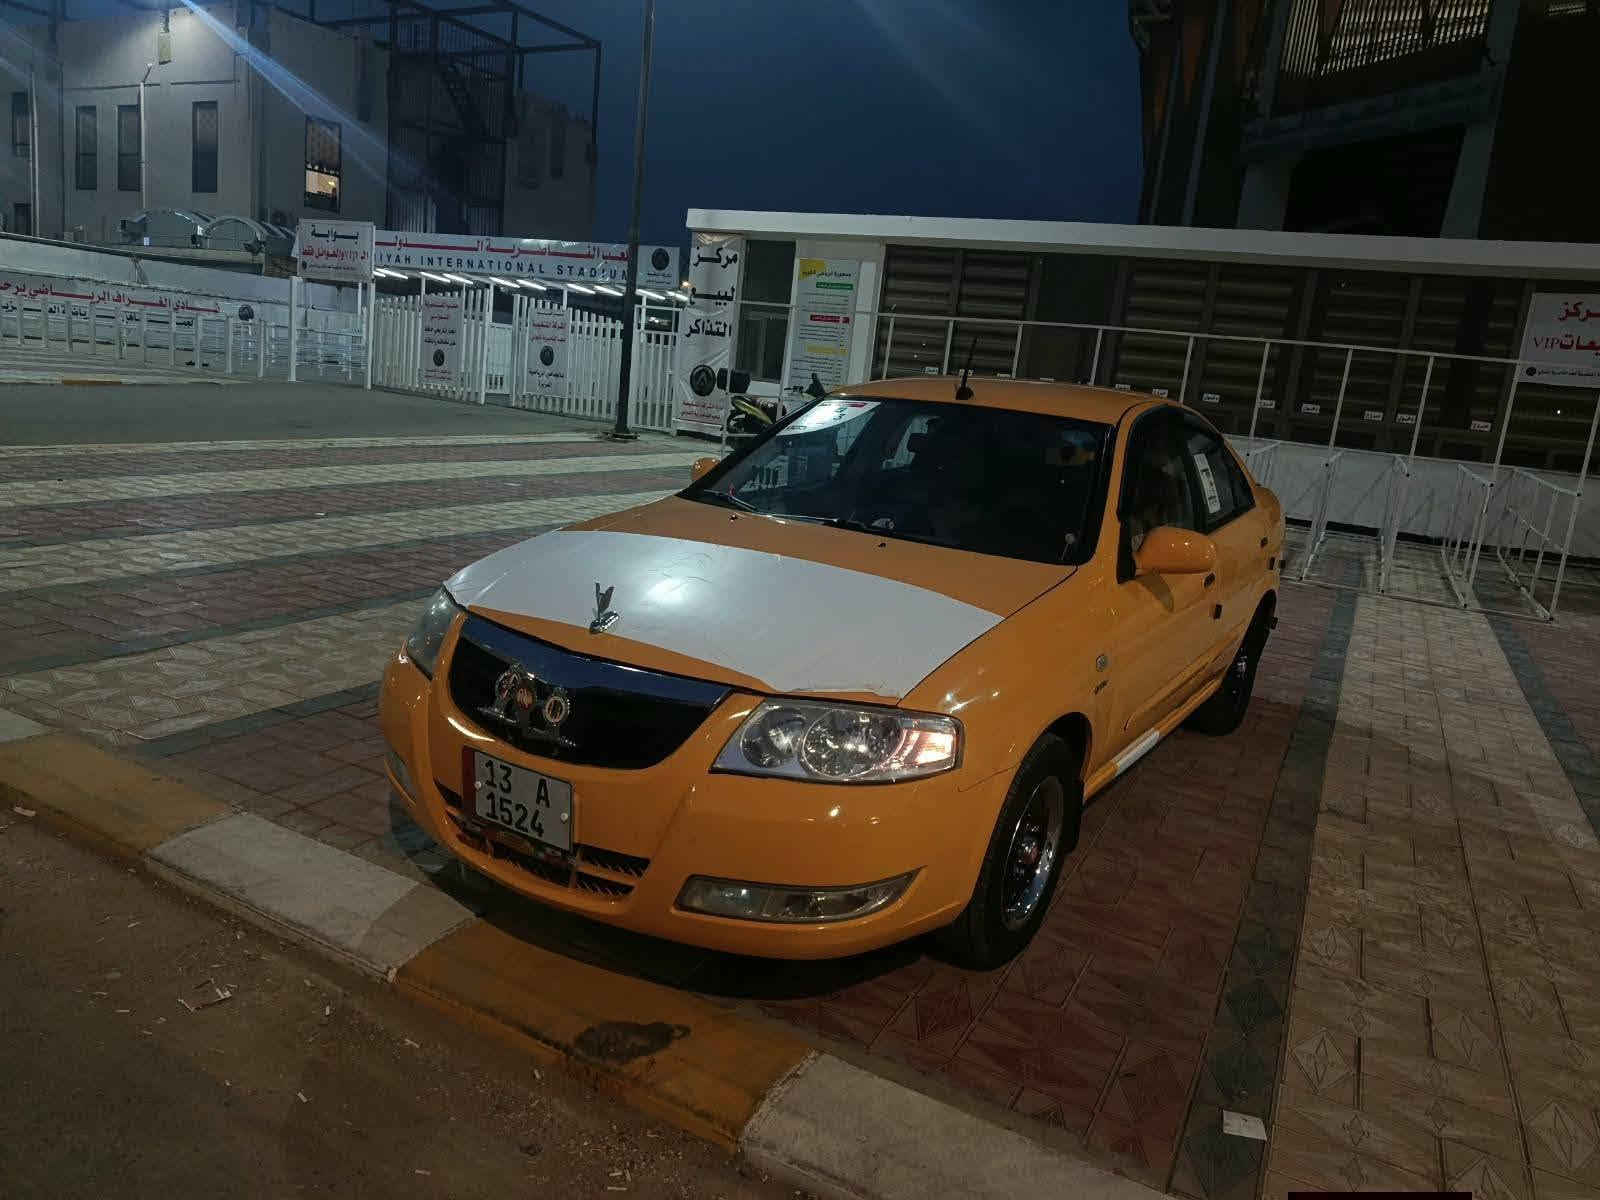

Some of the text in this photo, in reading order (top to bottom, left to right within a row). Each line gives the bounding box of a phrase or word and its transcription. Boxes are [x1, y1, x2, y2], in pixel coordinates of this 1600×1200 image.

[420, 255, 545, 274] INTERNATIONAL
[692, 245, 738, 269] مركز
[688, 285, 737, 306] لبيع
[1558, 299, 1600, 322] ركز
[684, 318, 733, 338] التذاكر
[1534, 336, 1560, 350] VIP
[485, 760, 551, 809] 13 A
[485, 791, 545, 838] 1524
